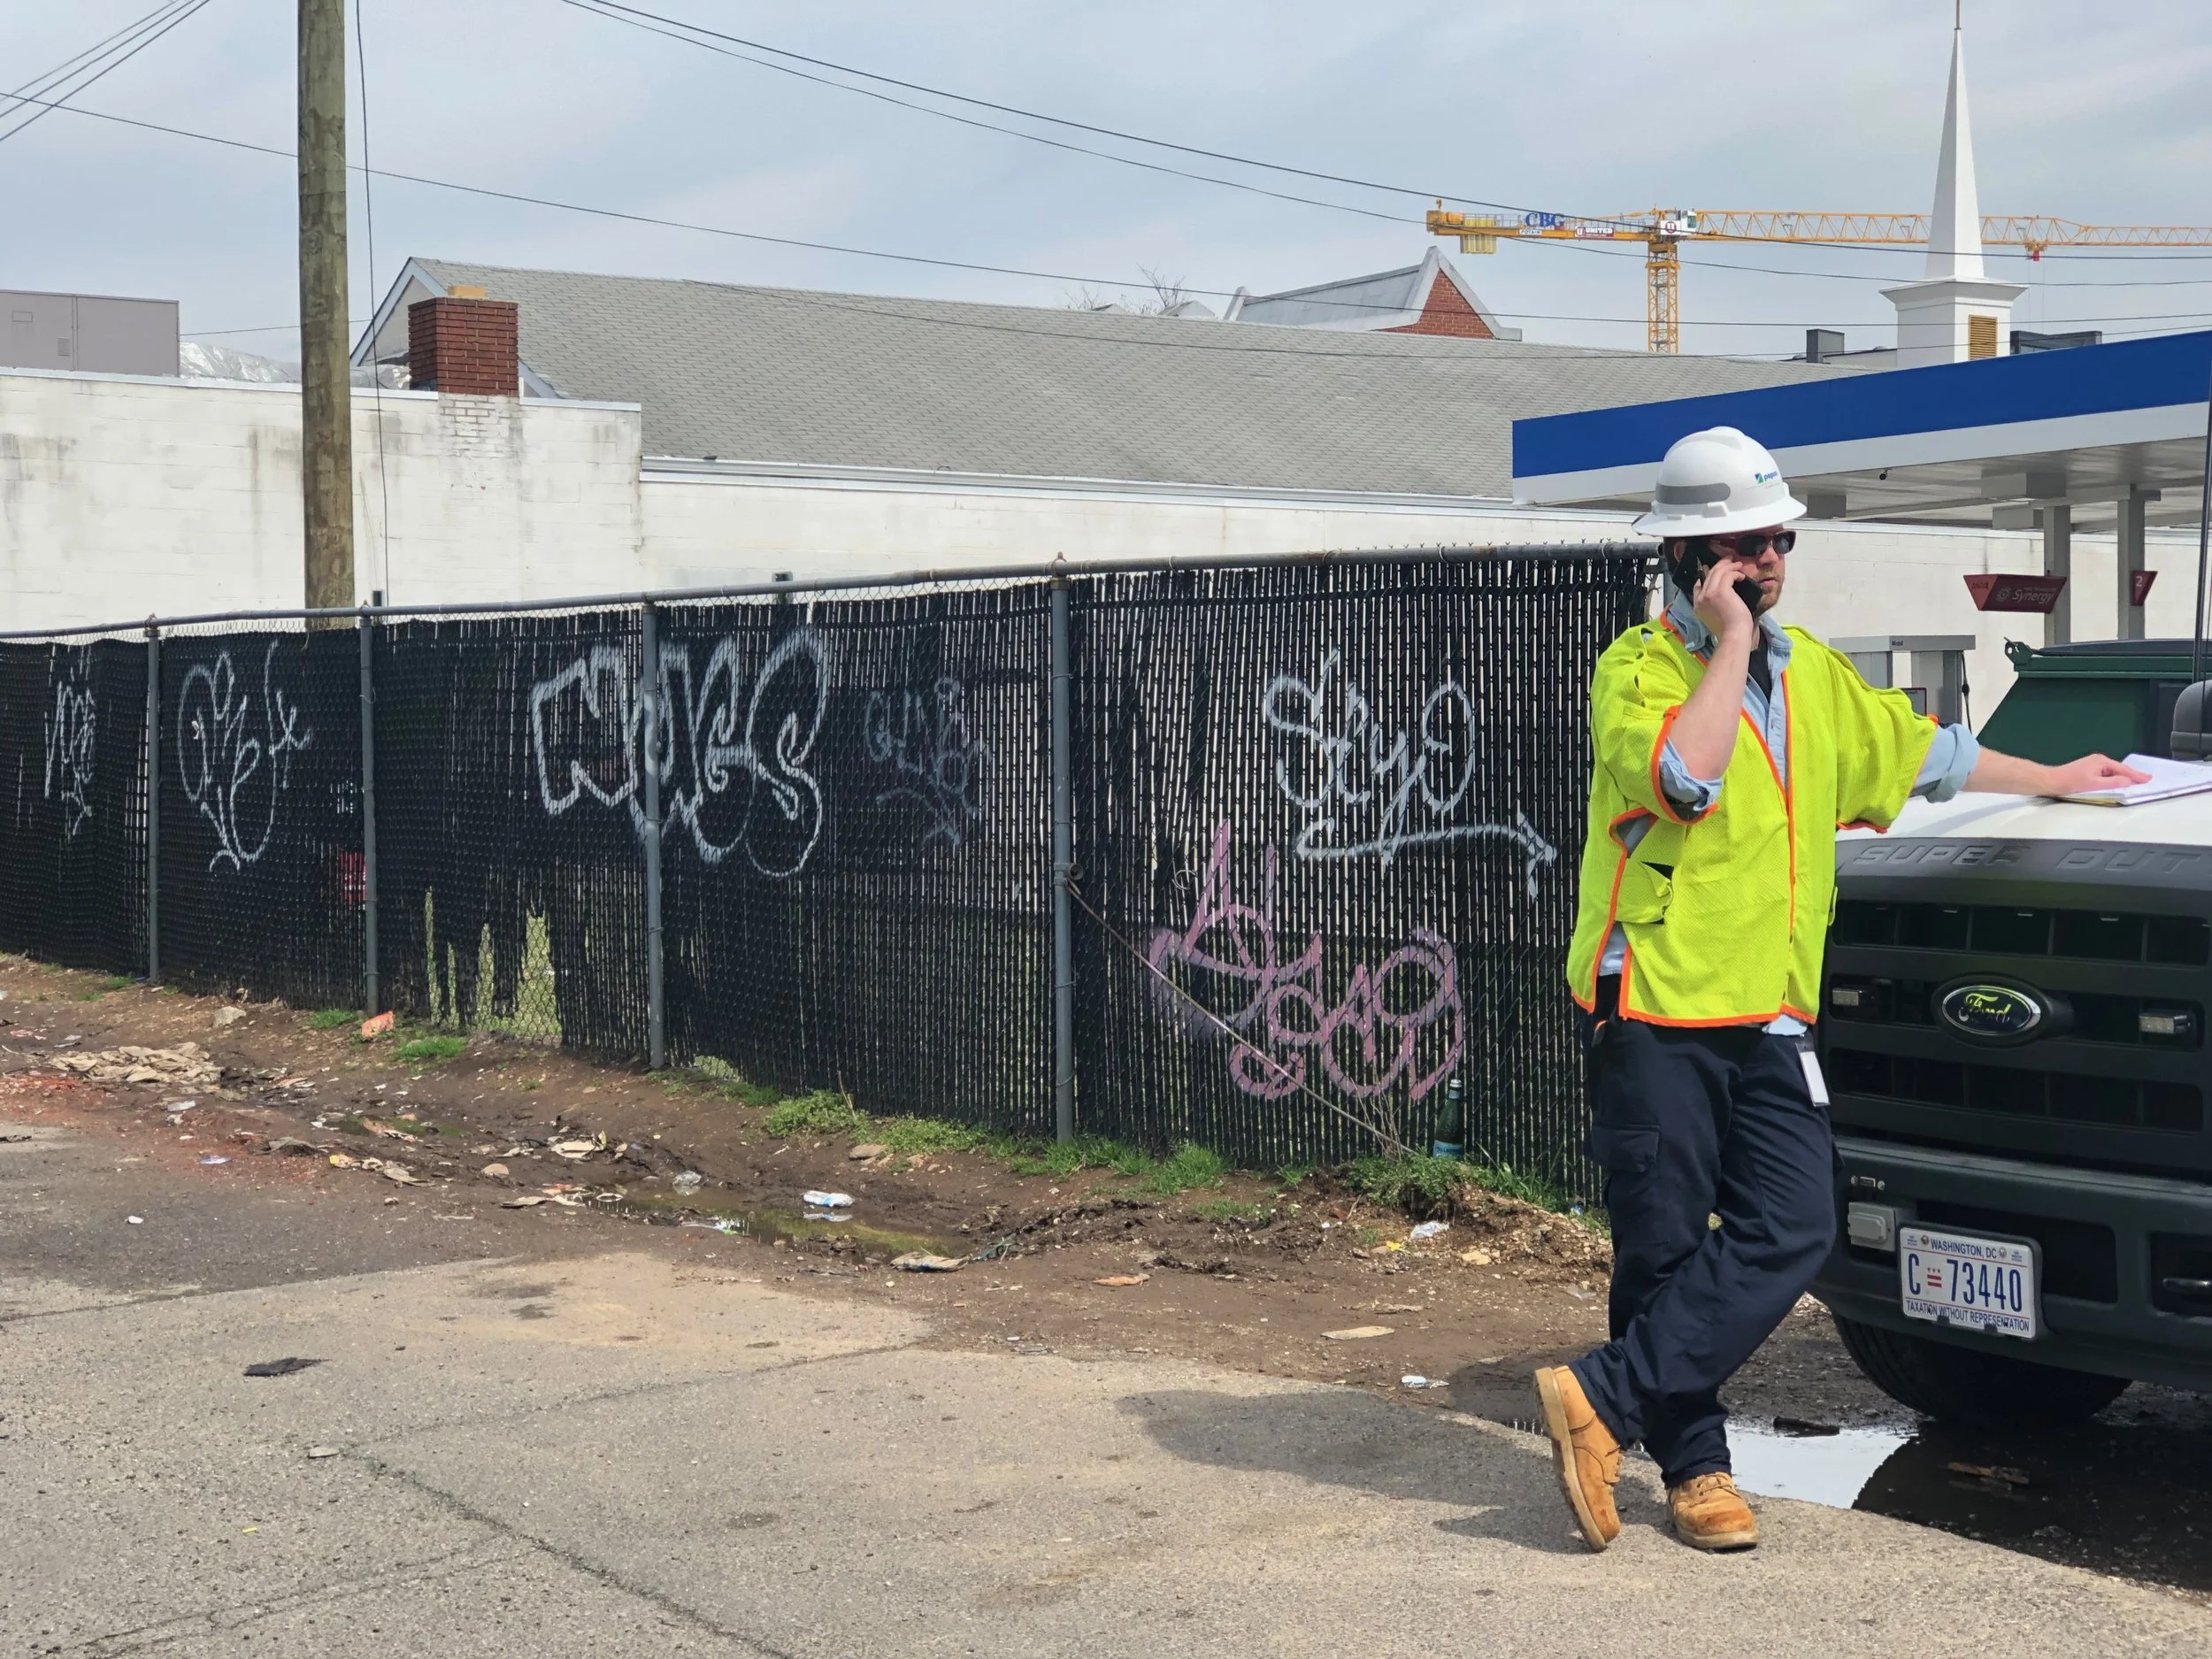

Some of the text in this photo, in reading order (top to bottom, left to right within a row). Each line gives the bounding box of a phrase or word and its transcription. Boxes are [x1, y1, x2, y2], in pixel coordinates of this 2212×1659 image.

[2011, 588, 2055, 604] Synergy
[2135, 575, 2143, 588] 2
[1853, 844, 2212, 877] SUPER DUT
[1958, 993, 2011, 1023] Ford
[1985, 1247, 1997, 1259] DC
[1908, 1253, 2022, 1313] C 73440
[1906, 1300, 2030, 1333] TAXATION WITHOUT REPRESENTATION
